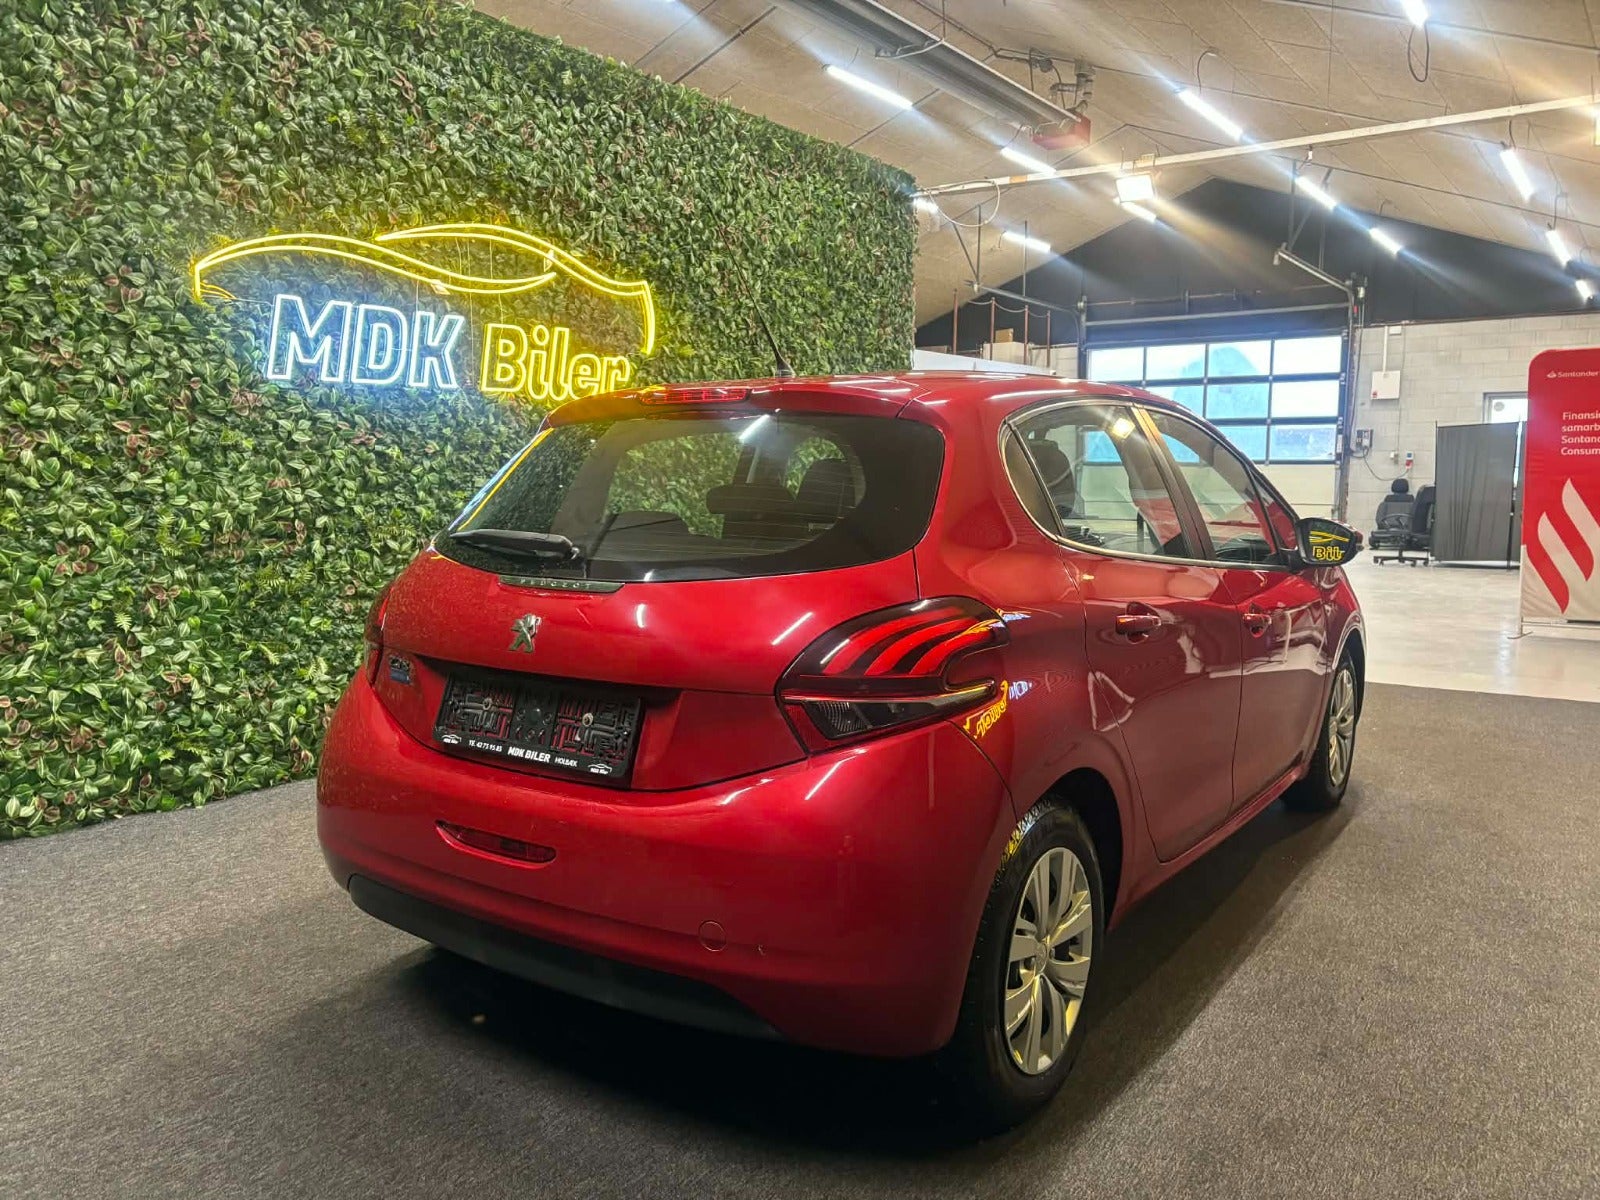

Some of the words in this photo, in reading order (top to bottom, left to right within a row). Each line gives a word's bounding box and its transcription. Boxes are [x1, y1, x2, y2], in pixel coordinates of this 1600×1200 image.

[267, 294, 464, 389] MDK
[480, 323, 631, 400] Biler
[1558, 370, 1599, 378] Santander
[1562, 410, 1600, 421] Finansi
[1561, 447, 1600, 456] Consum
[507, 746, 525, 759] MDK
[525, 750, 551, 763] BILER
